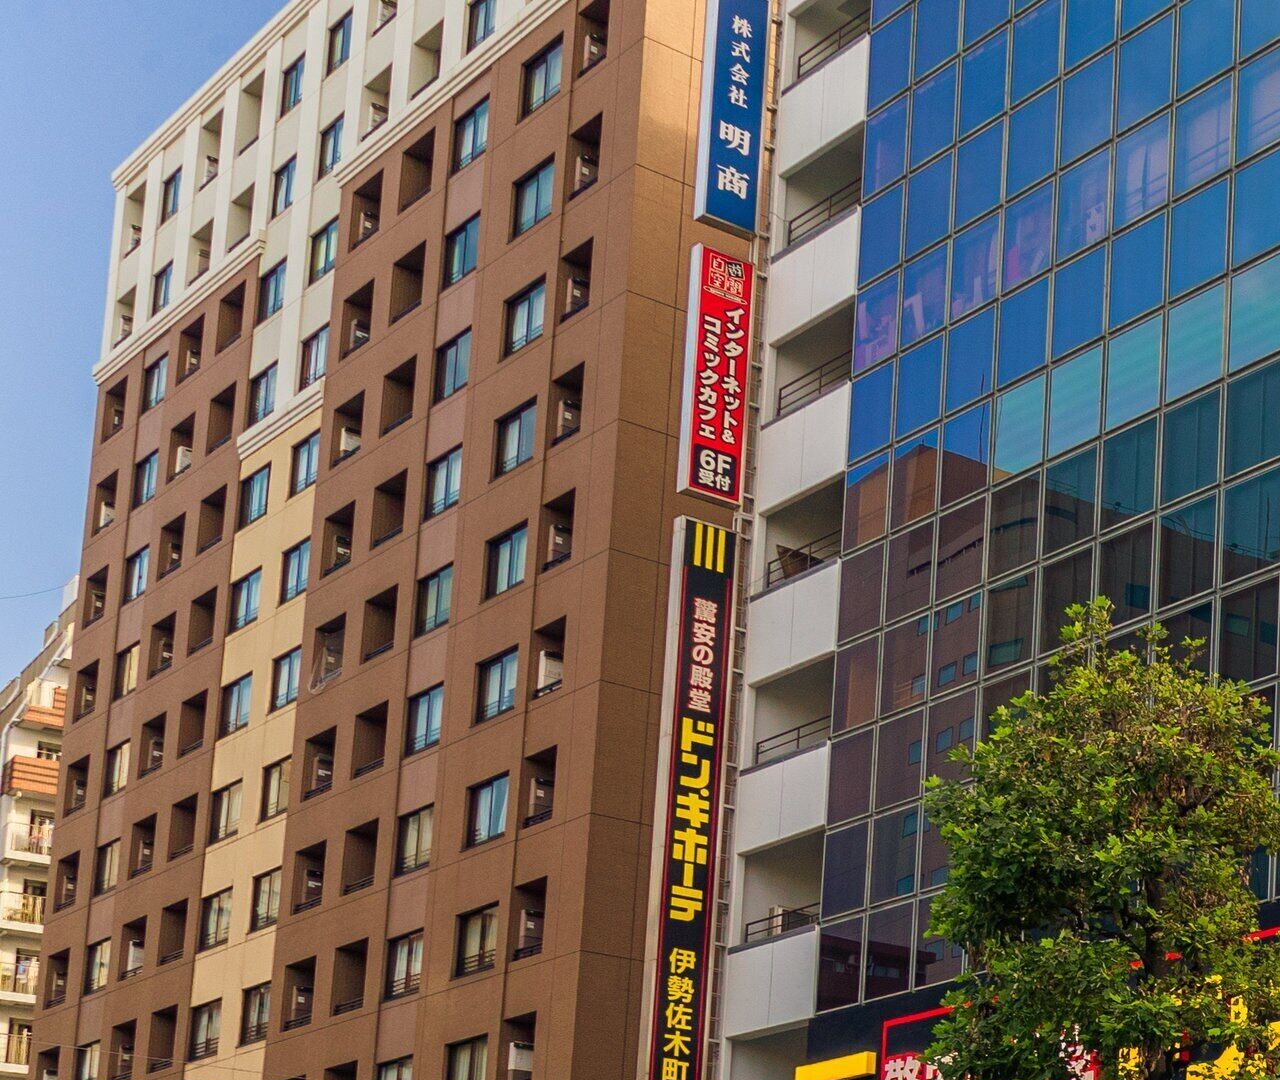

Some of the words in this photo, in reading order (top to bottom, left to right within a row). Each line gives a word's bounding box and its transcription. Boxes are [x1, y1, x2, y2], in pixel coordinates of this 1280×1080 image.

[728, 15, 753, 109] 株式会社
[717, 120, 751, 201] 明商
[696, 315, 722, 441] コミックカフェ
[721, 308, 746, 445] インターネット&
[697, 469, 731, 492] 受付
[699, 448, 732, 474] 6F
[689, 597, 717, 713] 驚安の殿堂
